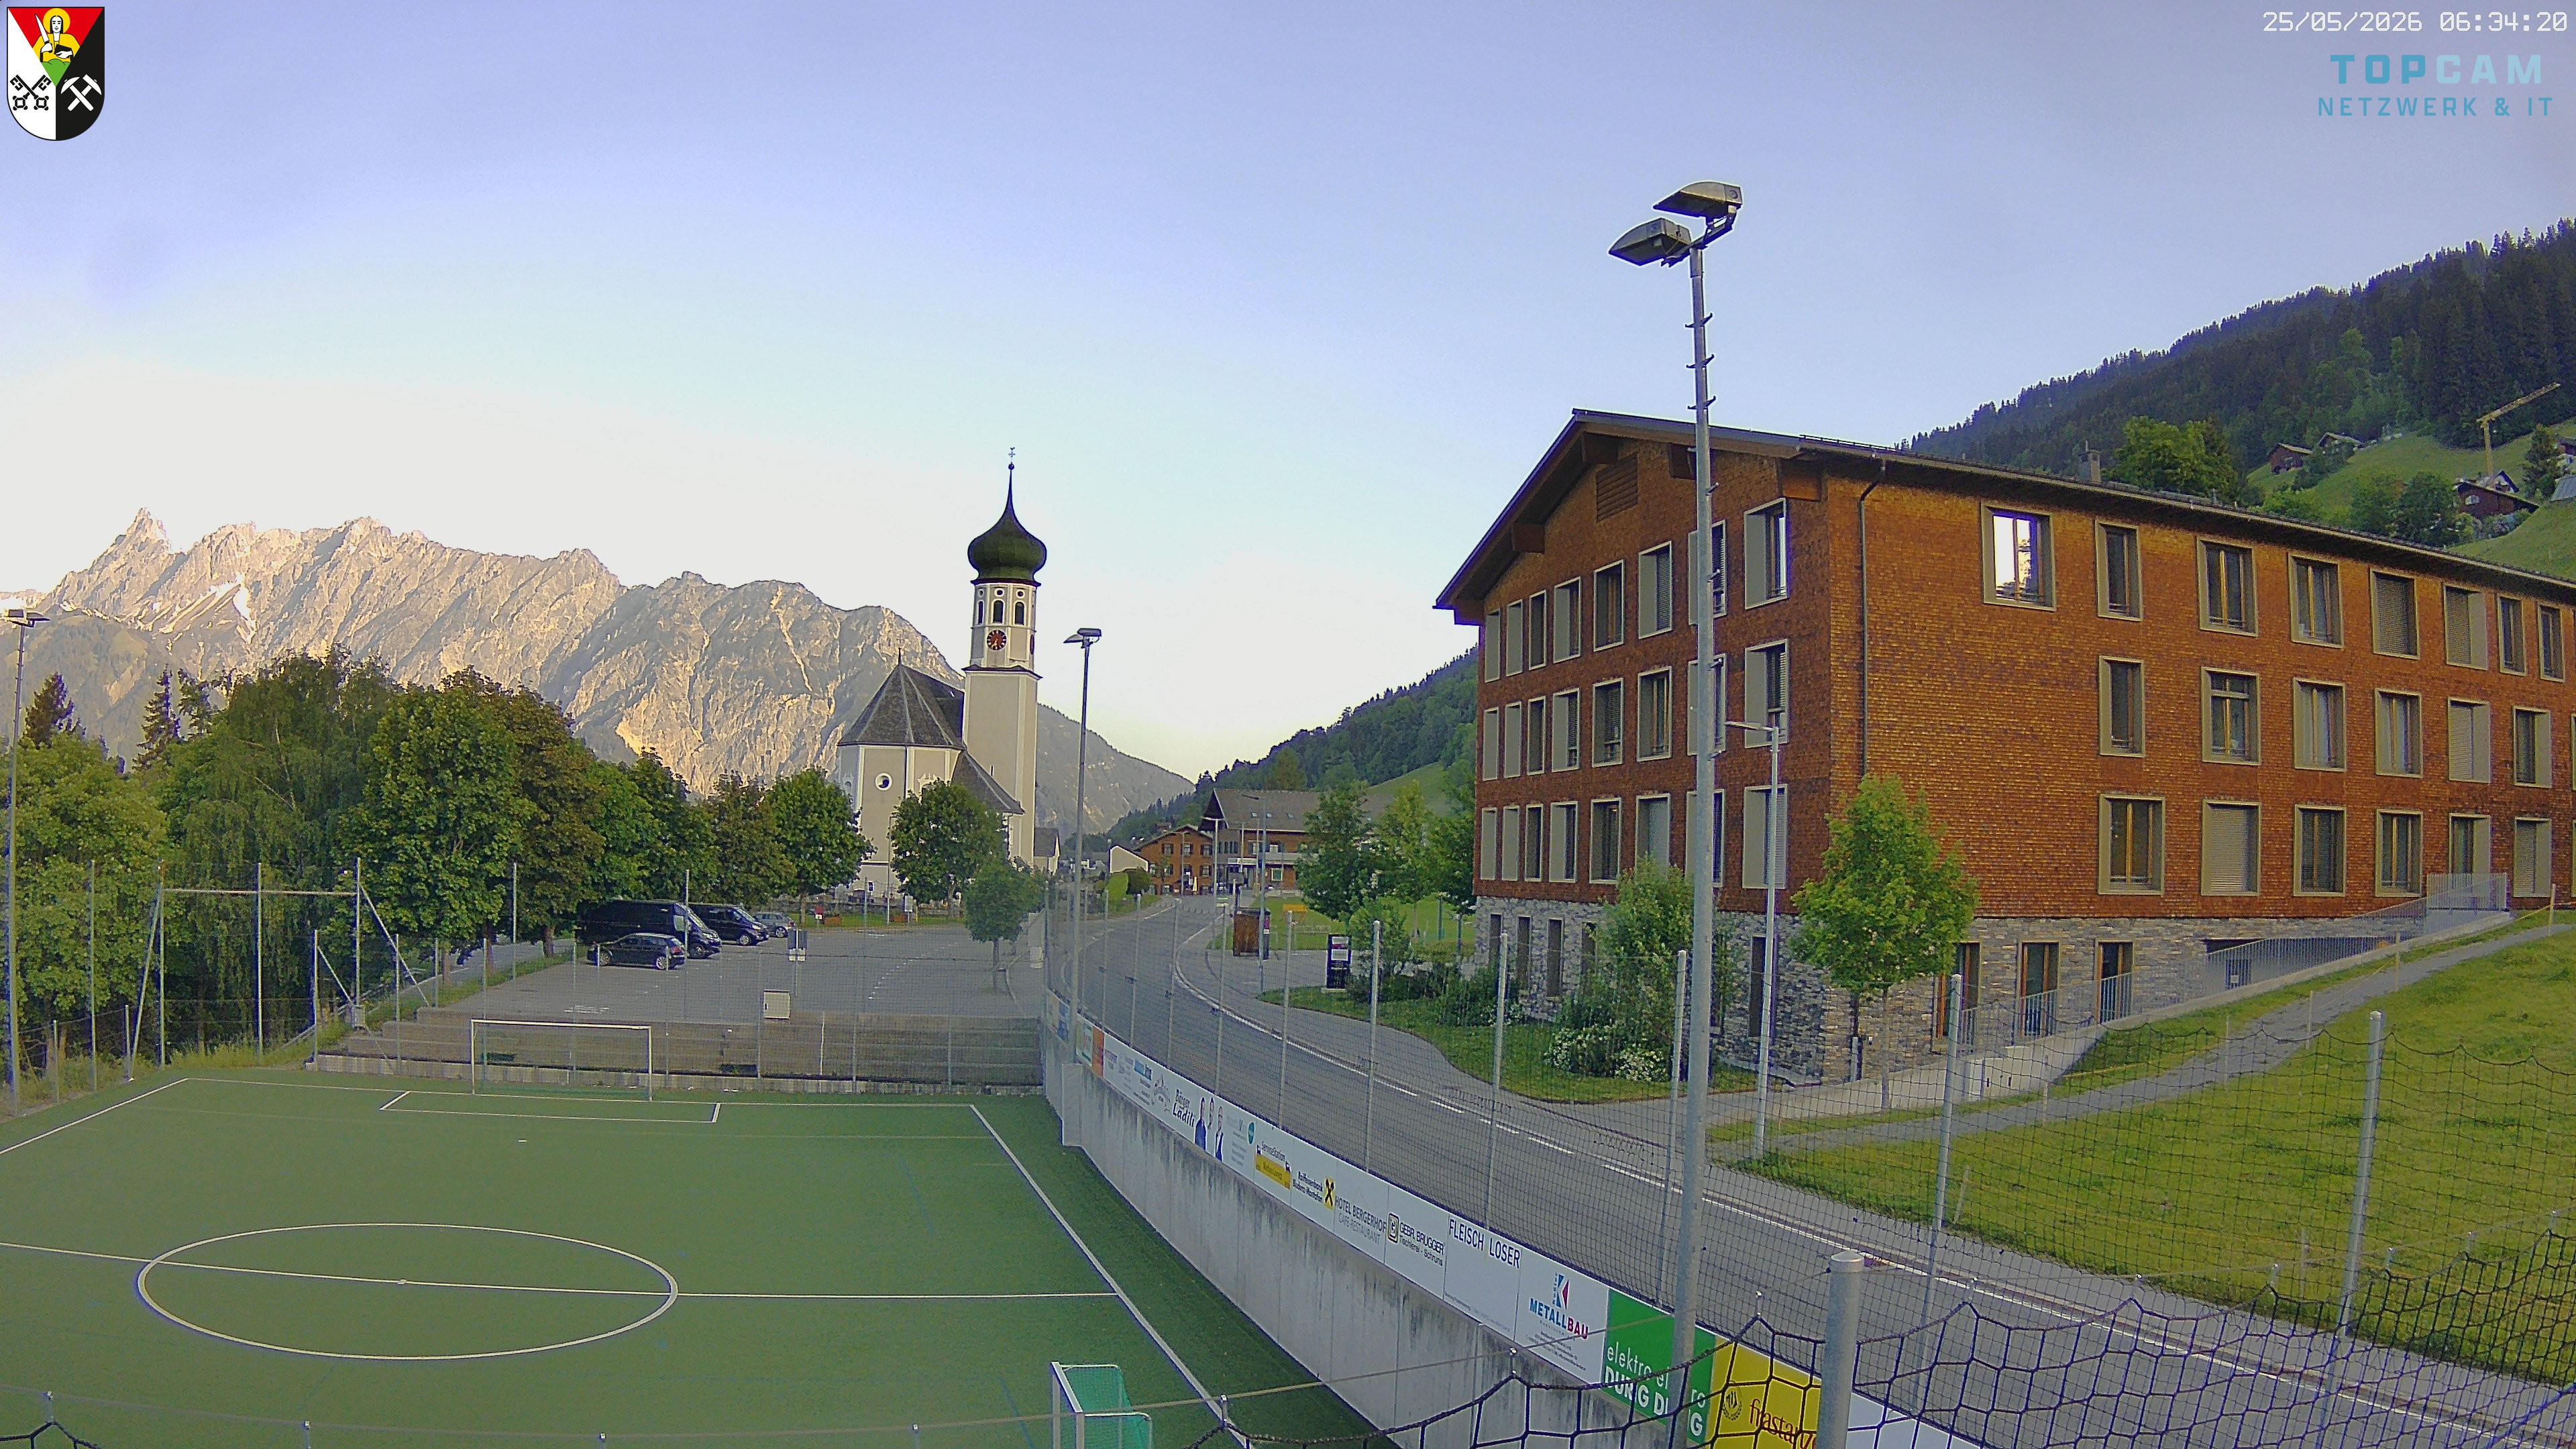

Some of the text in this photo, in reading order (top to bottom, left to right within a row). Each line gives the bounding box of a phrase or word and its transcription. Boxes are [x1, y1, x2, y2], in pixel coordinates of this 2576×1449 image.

[1335, 1195, 1387, 1233] HOTEL BERGERHOF
[1449, 1218, 1520, 1268] FLEISCH LOSER
[1529, 1297, 1589, 1340] METALLBAU
